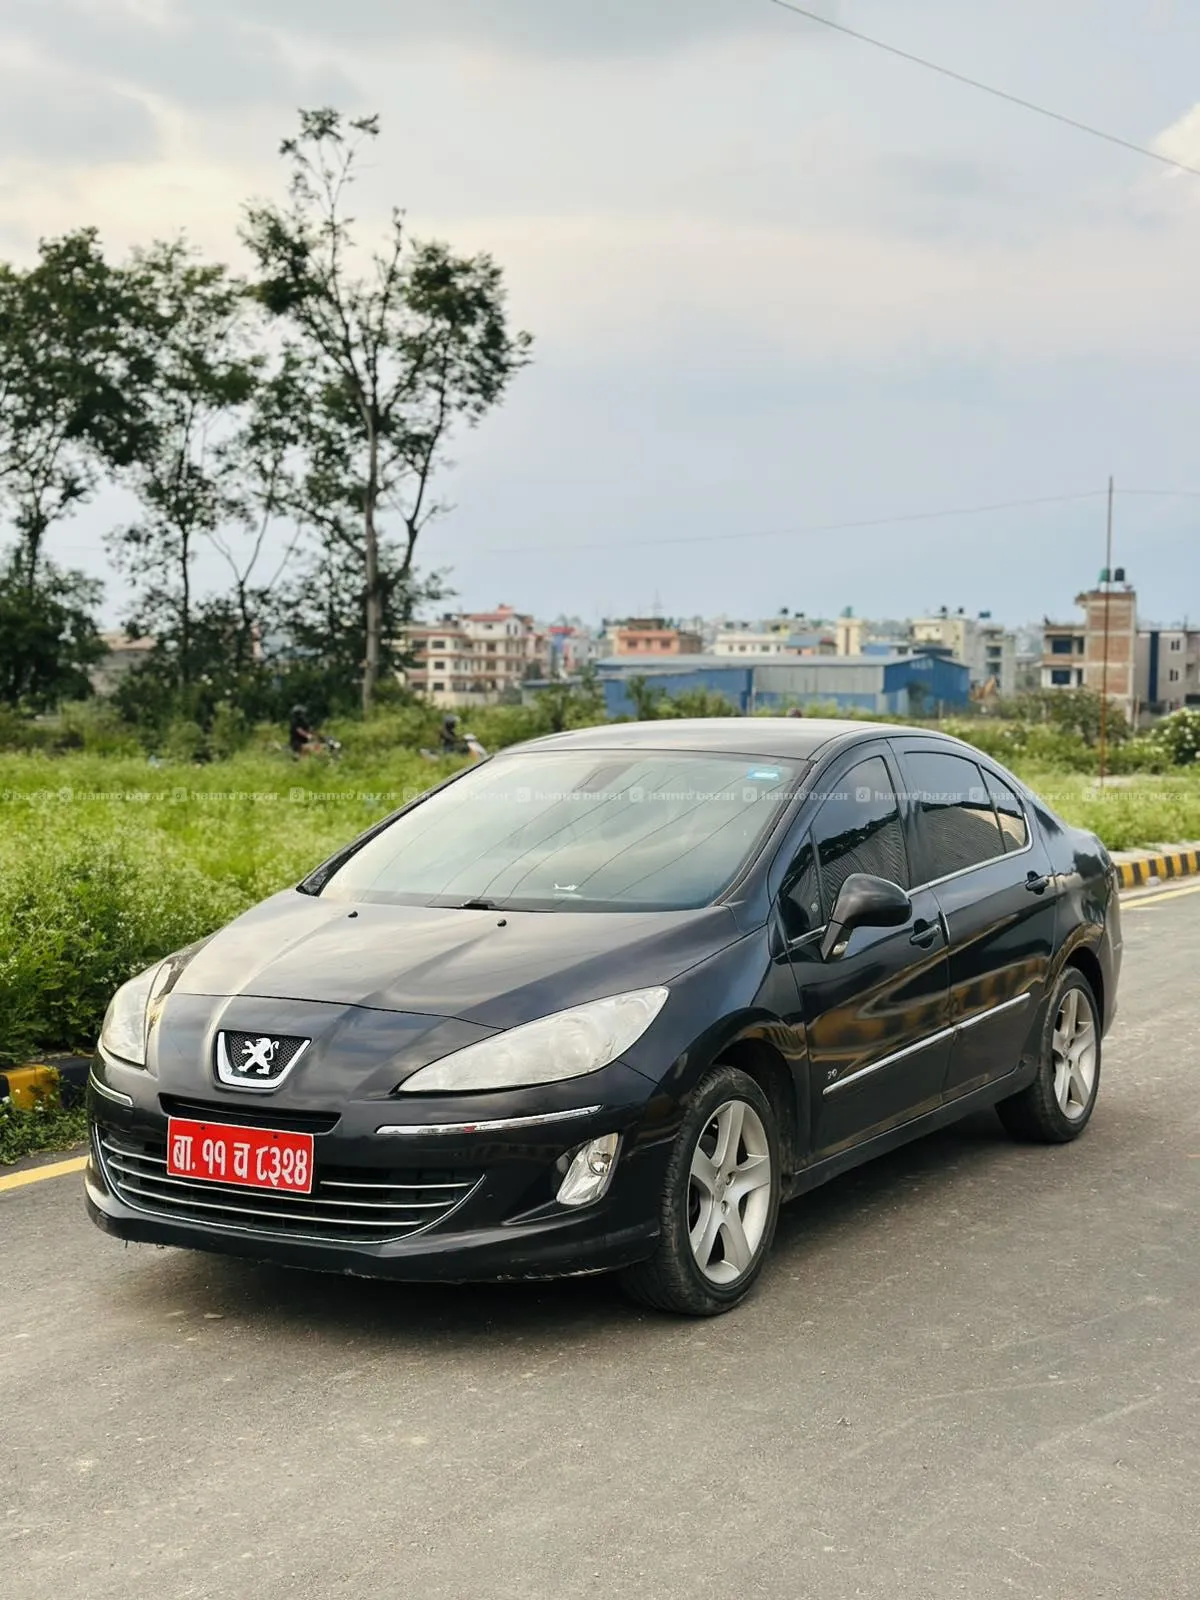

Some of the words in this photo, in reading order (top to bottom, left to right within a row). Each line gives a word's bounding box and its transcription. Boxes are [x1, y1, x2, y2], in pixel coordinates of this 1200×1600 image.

[202, 1138, 227, 1176] ११
[233, 1142, 251, 1179] च
[255, 1145, 308, 1186] ८३२४
